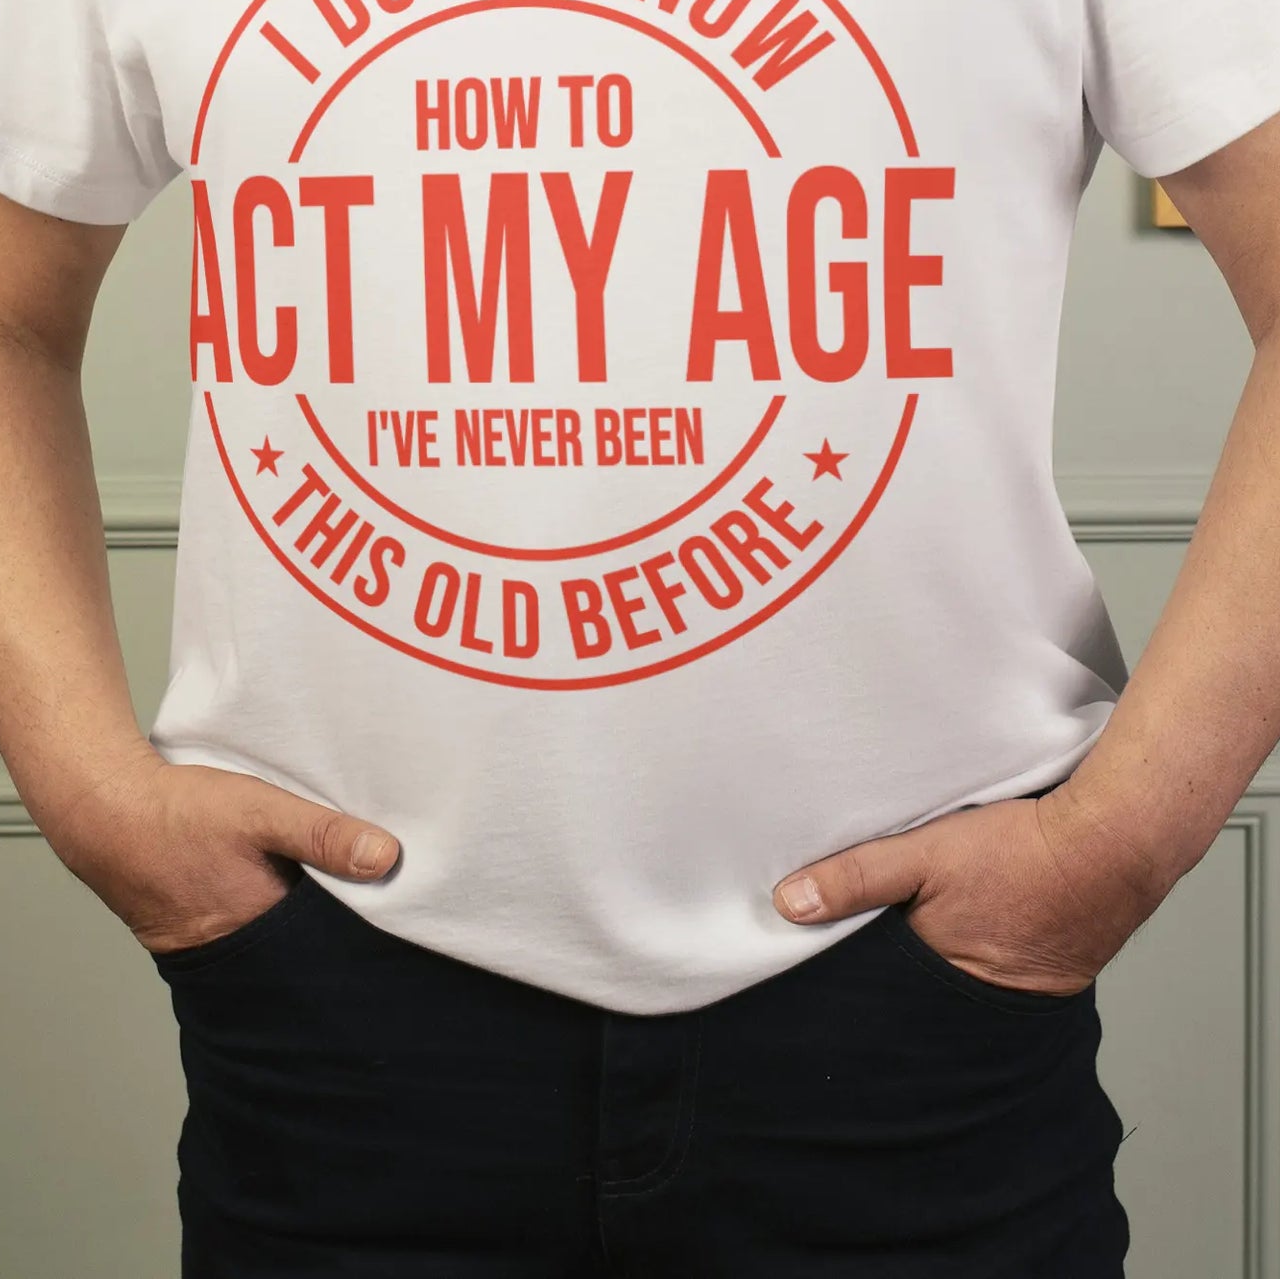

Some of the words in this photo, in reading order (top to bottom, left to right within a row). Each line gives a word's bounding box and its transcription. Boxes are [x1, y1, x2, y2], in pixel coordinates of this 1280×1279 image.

[259, 21, 321, 84] I
[415, 76, 542, 151] HOW
[557, 73, 634, 150] TO
[189, 174, 375, 387] ACT
[421, 170, 634, 384] MY
[685, 164, 956, 384] AGE
[366, 408, 441, 469] I'VE
[454, 408, 584, 468] NEVER
[593, 407, 705, 467] BEEN
[271, 463, 407, 608] THIS
[413, 561, 540, 660] OLD
[560, 476, 825, 660] BEFORE
